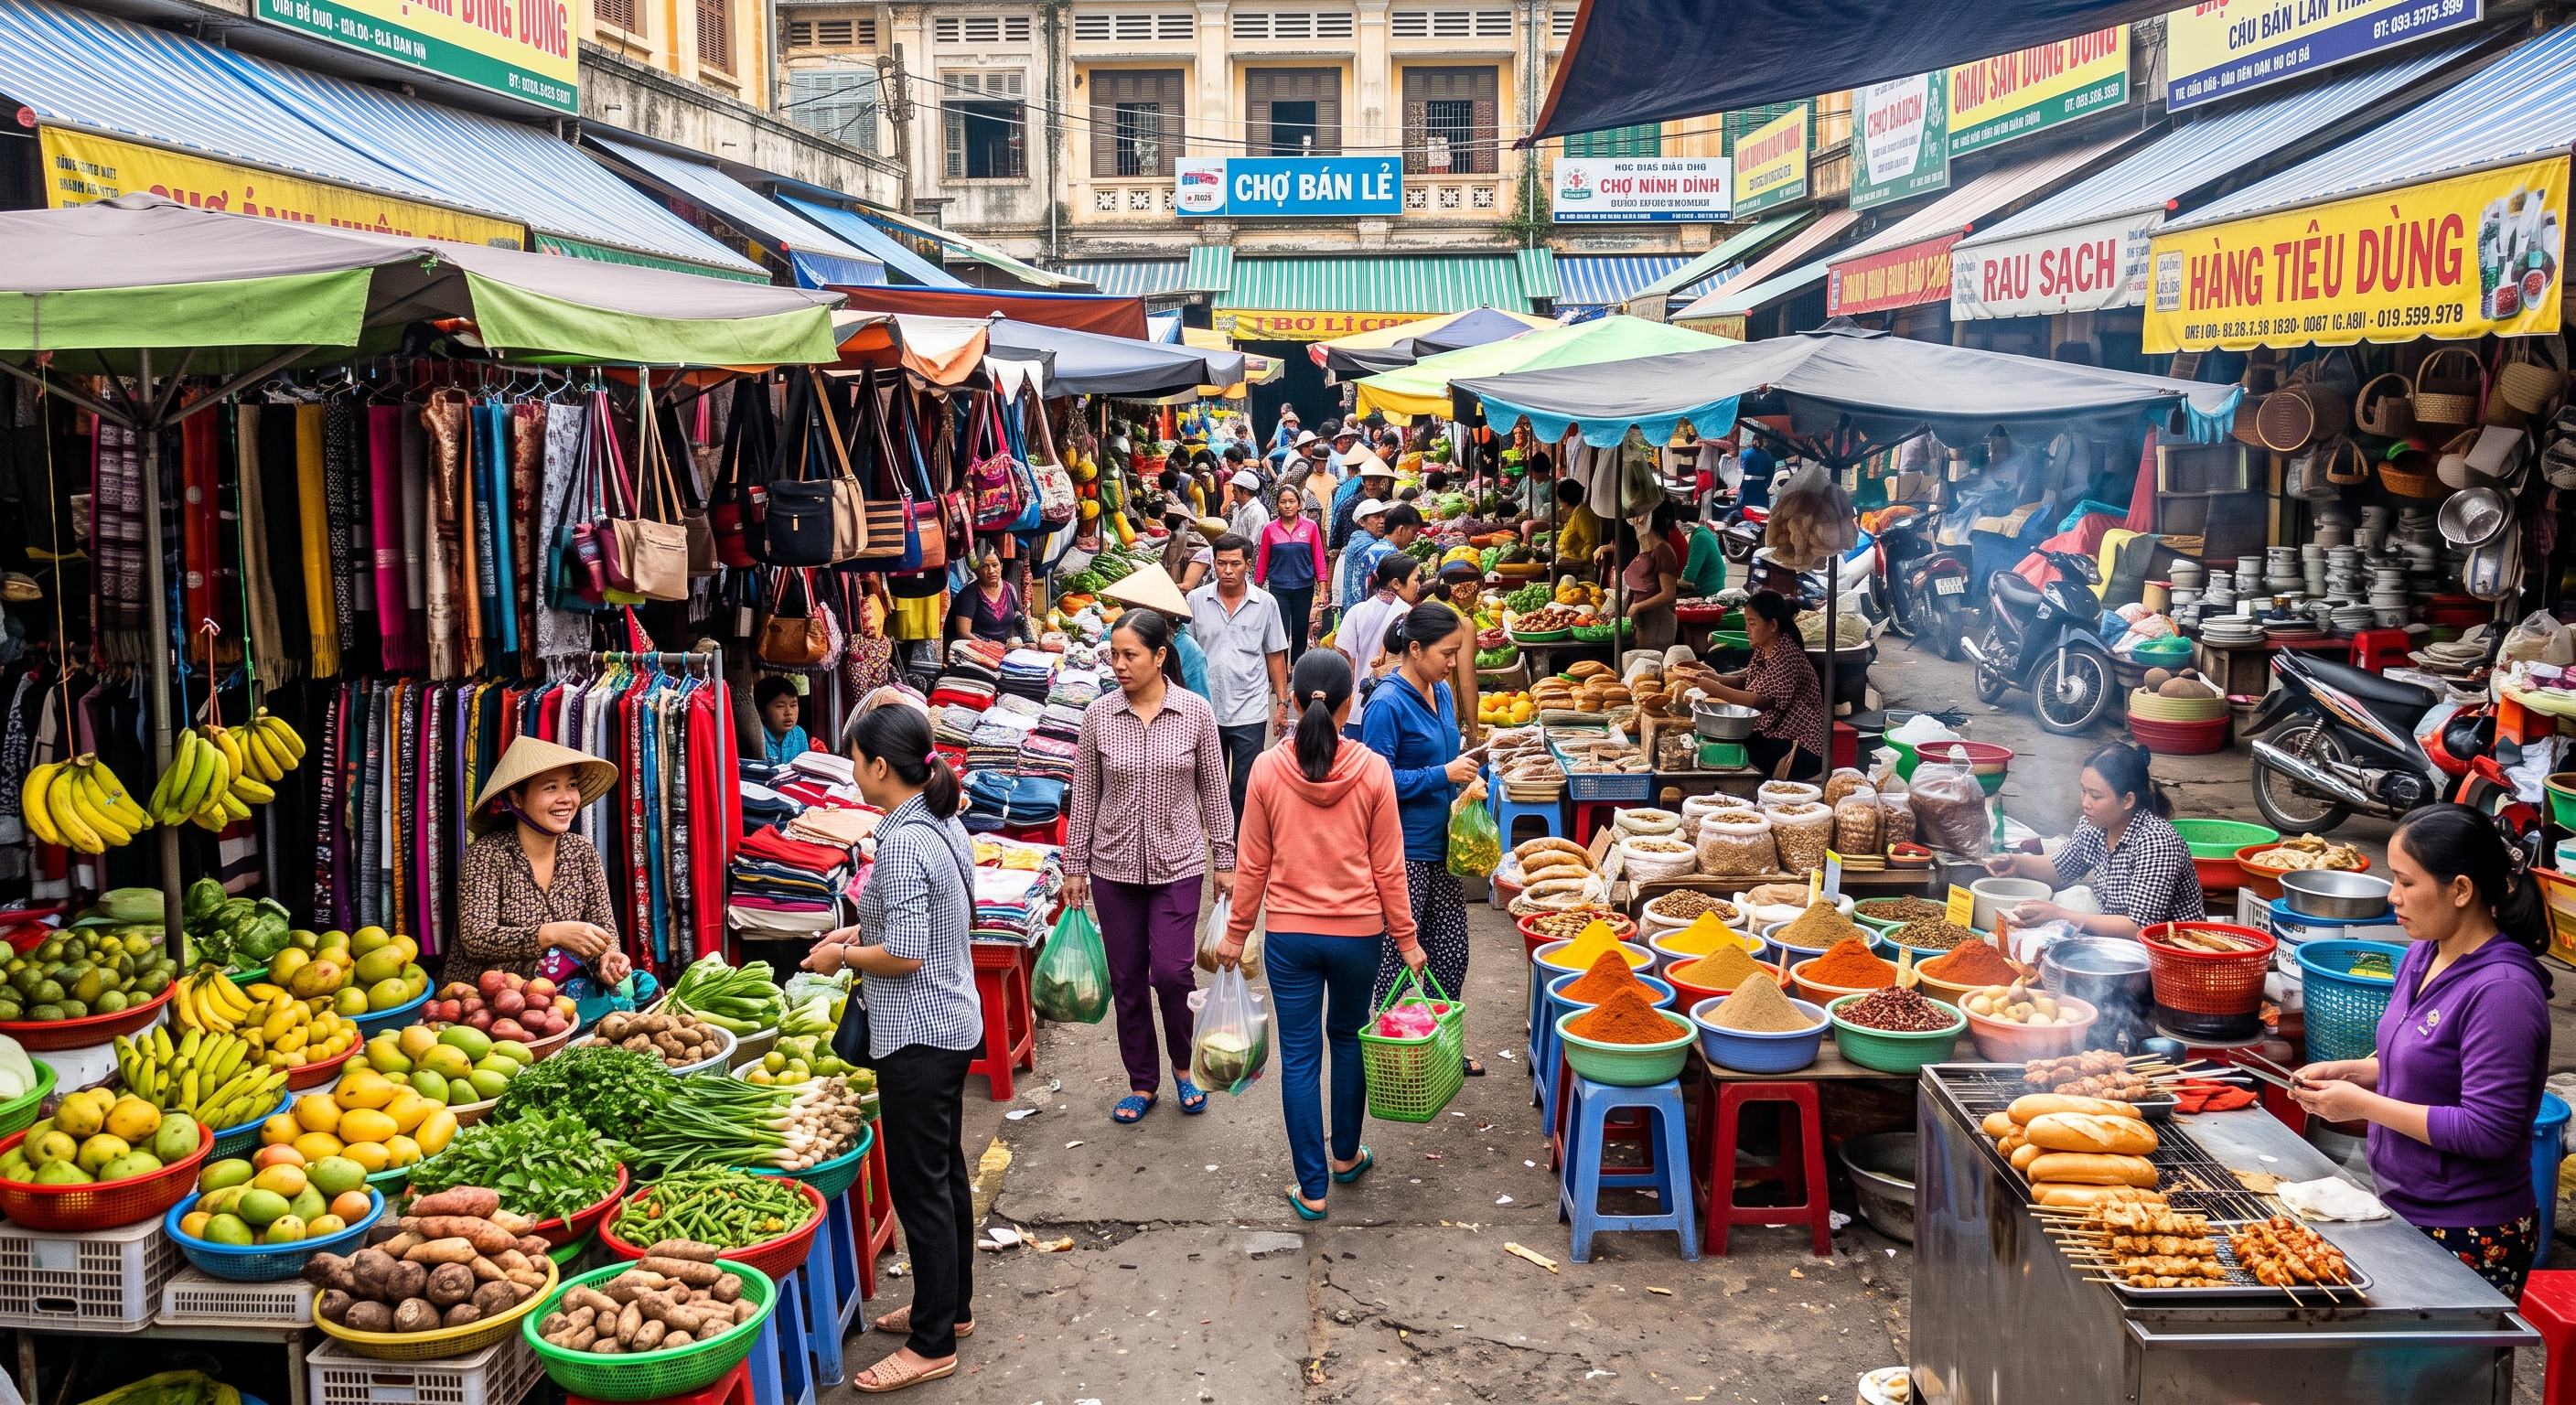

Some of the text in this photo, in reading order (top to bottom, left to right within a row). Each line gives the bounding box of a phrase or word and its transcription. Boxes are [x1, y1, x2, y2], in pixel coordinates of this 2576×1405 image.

[1235, 162, 1393, 208] CHỢ BÁN LẺ
[1983, 253, 2030, 303] RAU
[2039, 238, 2116, 305] SẠCH
[2188, 204, 2464, 311] HÀNG TIÊU DÙNG
